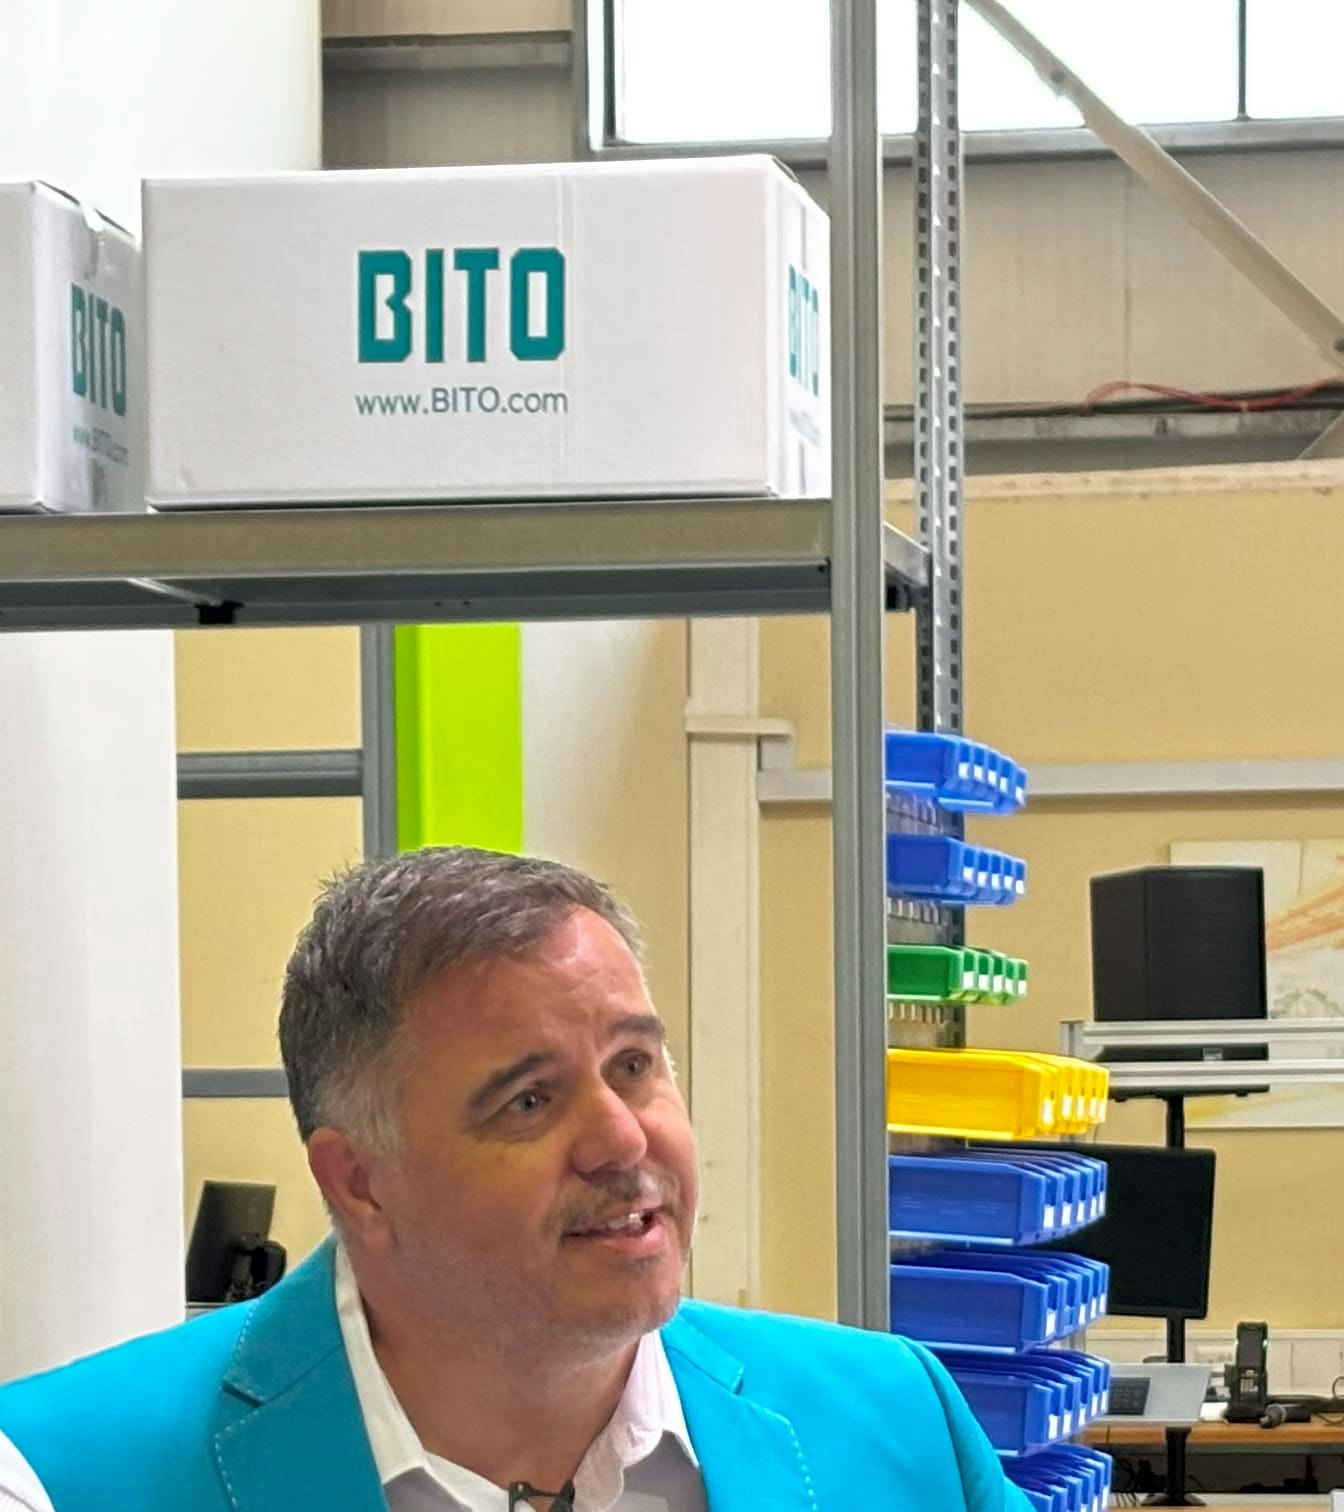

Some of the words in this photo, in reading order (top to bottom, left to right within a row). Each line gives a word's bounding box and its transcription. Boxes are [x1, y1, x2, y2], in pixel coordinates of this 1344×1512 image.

[71, 283, 126, 416] BITO
[357, 246, 566, 364] BITO
[356, 386, 568, 416] www.BITO.com
